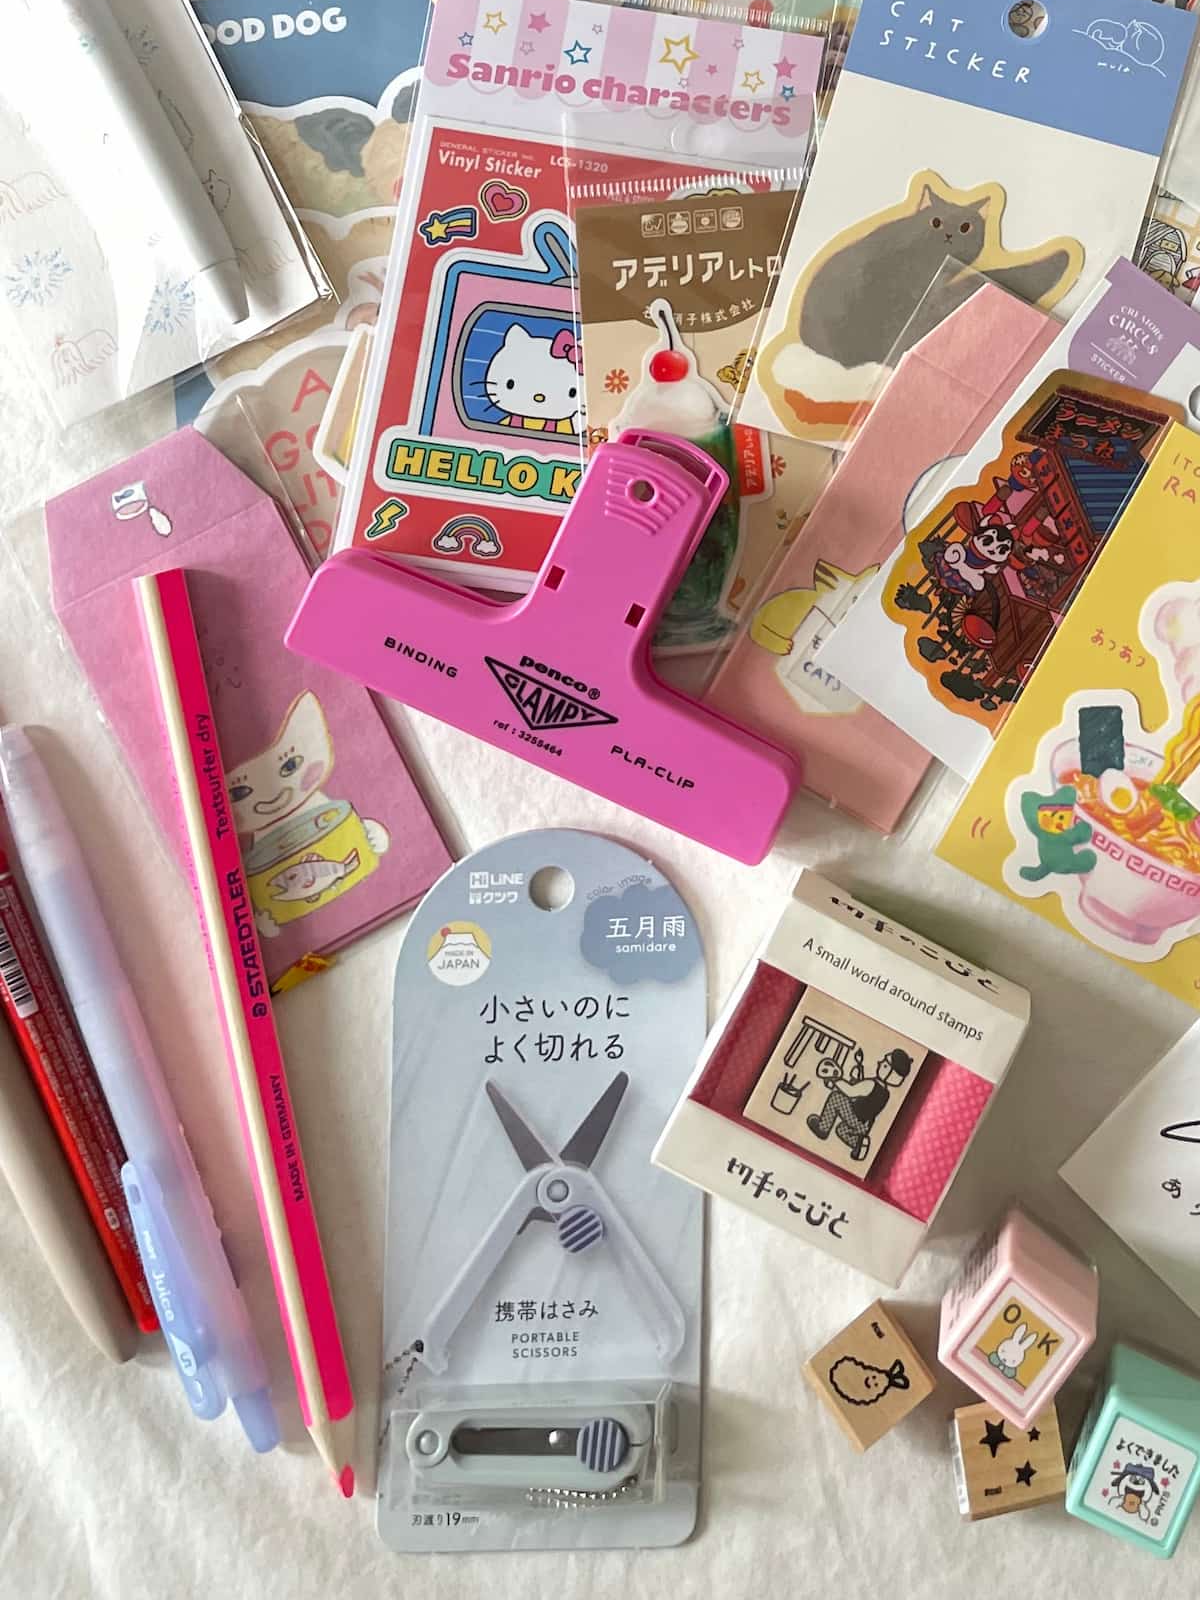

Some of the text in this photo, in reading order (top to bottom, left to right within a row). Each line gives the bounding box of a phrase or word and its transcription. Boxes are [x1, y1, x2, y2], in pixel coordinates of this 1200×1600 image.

[279, 7, 348, 41] DOG
[890, 0, 965, 33] CAT
[880, 29, 1031, 84] STICKER
[446, 53, 792, 127] Sanrio characters
[439, 149, 543, 180] Vinyl Sticker
[1108, 313, 1160, 357] CIRCUS
[392, 444, 539, 490] HELLO
[383, 636, 458, 678] BINDING
[502, 671, 596, 725] CLAMPY
[194, 712, 236, 841] Textsurfer dry
[610, 743, 696, 792] PLA-CLIP
[228, 866, 268, 1000] STAEDTLER
[606, 915, 686, 939] 五月雨
[615, 942, 677, 954] samidare
[437, 959, 481, 971] JAPAN
[479, 994, 631, 1025] 小さいのに
[802, 937, 986, 1043] A small world around stamps
[484, 1032, 626, 1064] よく切れる
[269, 1073, 293, 1143] GERMANY
[289, 1160, 305, 1203] MADE
[150, 1269, 176, 1323] Juice
[495, 1300, 600, 1323] 携帯はさみ
[511, 1331, 581, 1345] PORTABLE
[512, 1346, 578, 1360] SCISSORS
